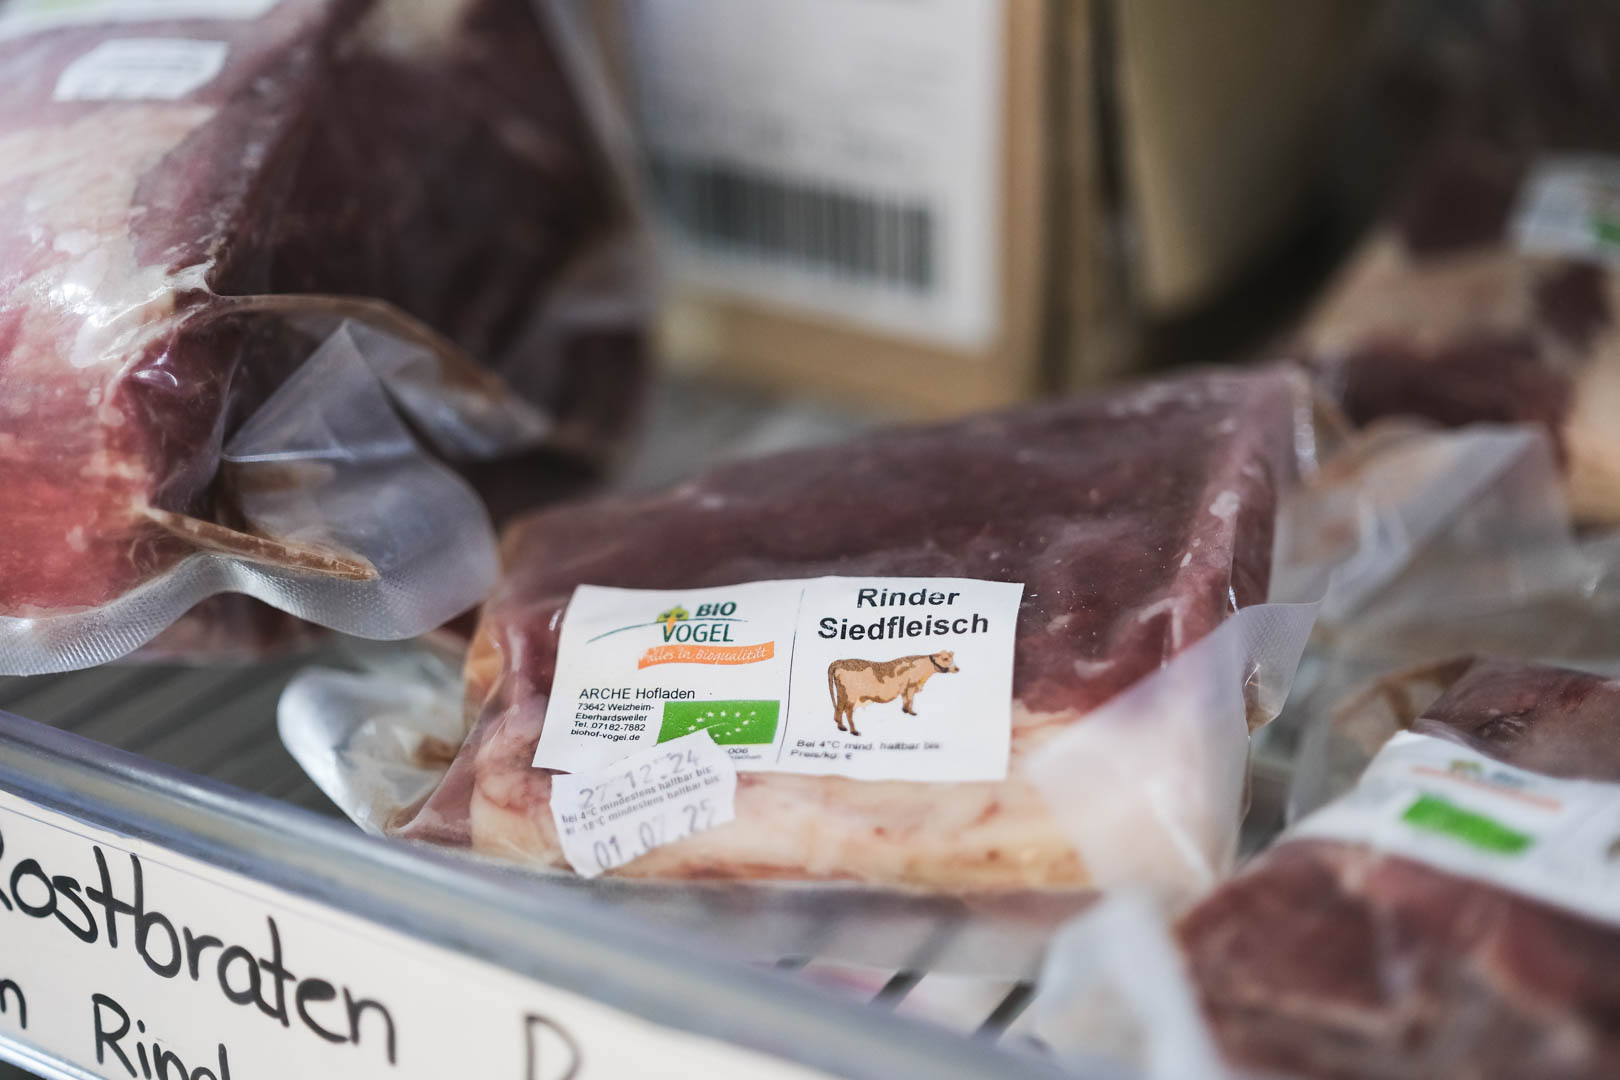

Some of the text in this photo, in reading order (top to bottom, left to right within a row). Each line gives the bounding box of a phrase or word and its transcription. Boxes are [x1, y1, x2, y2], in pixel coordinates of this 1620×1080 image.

[856, 588, 961, 609] Rinder
[695, 601, 738, 617] BIO
[662, 623, 735, 643] VOGEL
[817, 613, 989, 641] Siedfleisch
[578, 687, 696, 700] ARCHE Hofladen
[577, 703, 606, 711] 73642
[575, 712, 648, 722] Eberhardsweiler
[591, 722, 646, 732] 07182-7882
[570, 729, 641, 742] biohof-vogel.de
[0, 830, 398, 1066] ostbraten
